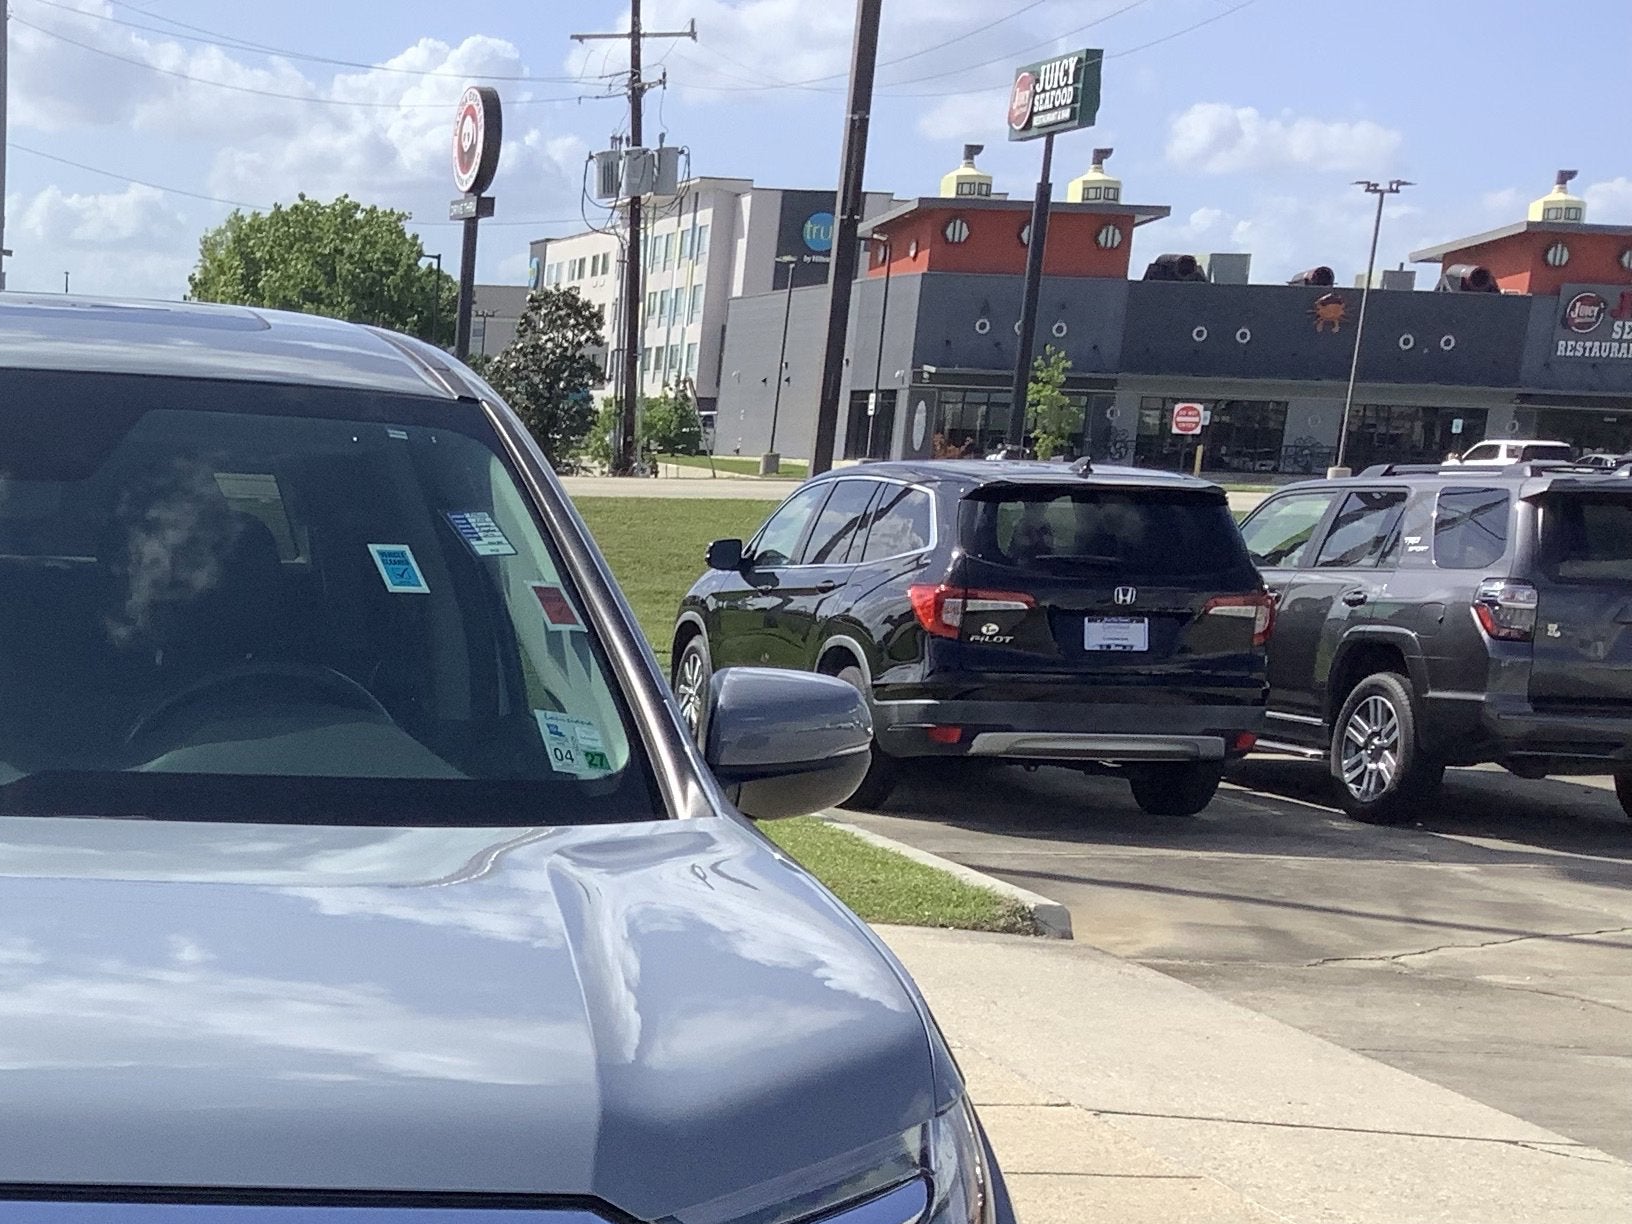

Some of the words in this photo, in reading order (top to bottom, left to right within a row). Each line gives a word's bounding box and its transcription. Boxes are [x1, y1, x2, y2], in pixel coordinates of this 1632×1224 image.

[1035, 56, 1078, 92] JUICY
[1033, 86, 1074, 113] SEAFOOD
[804, 220, 833, 240] tru
[969, 635, 1015, 644] PILOT
[553, 747, 574, 763] 04
[584, 752, 605, 768] 27
